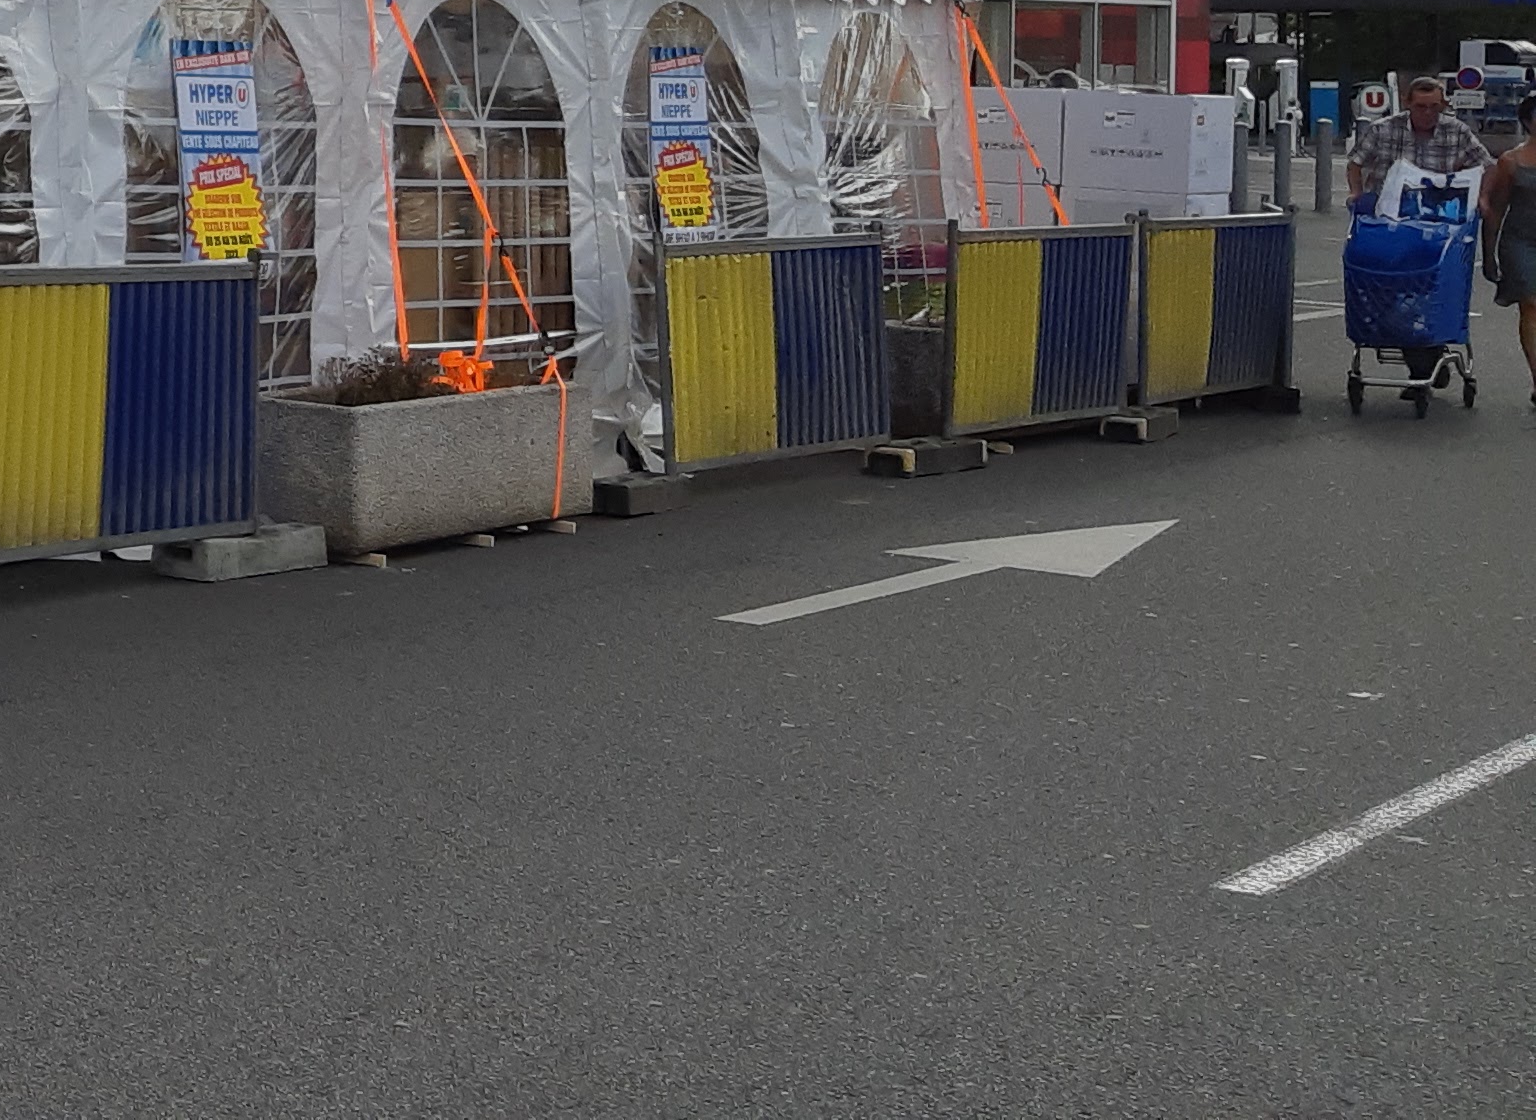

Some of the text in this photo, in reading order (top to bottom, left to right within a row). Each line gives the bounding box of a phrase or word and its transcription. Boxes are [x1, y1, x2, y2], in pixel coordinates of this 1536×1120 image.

[189, 83, 247, 103] HYPER U
[658, 82, 696, 100] HYPER U
[1365, 91, 1384, 108] U
[195, 109, 239, 126] NIEPPE
